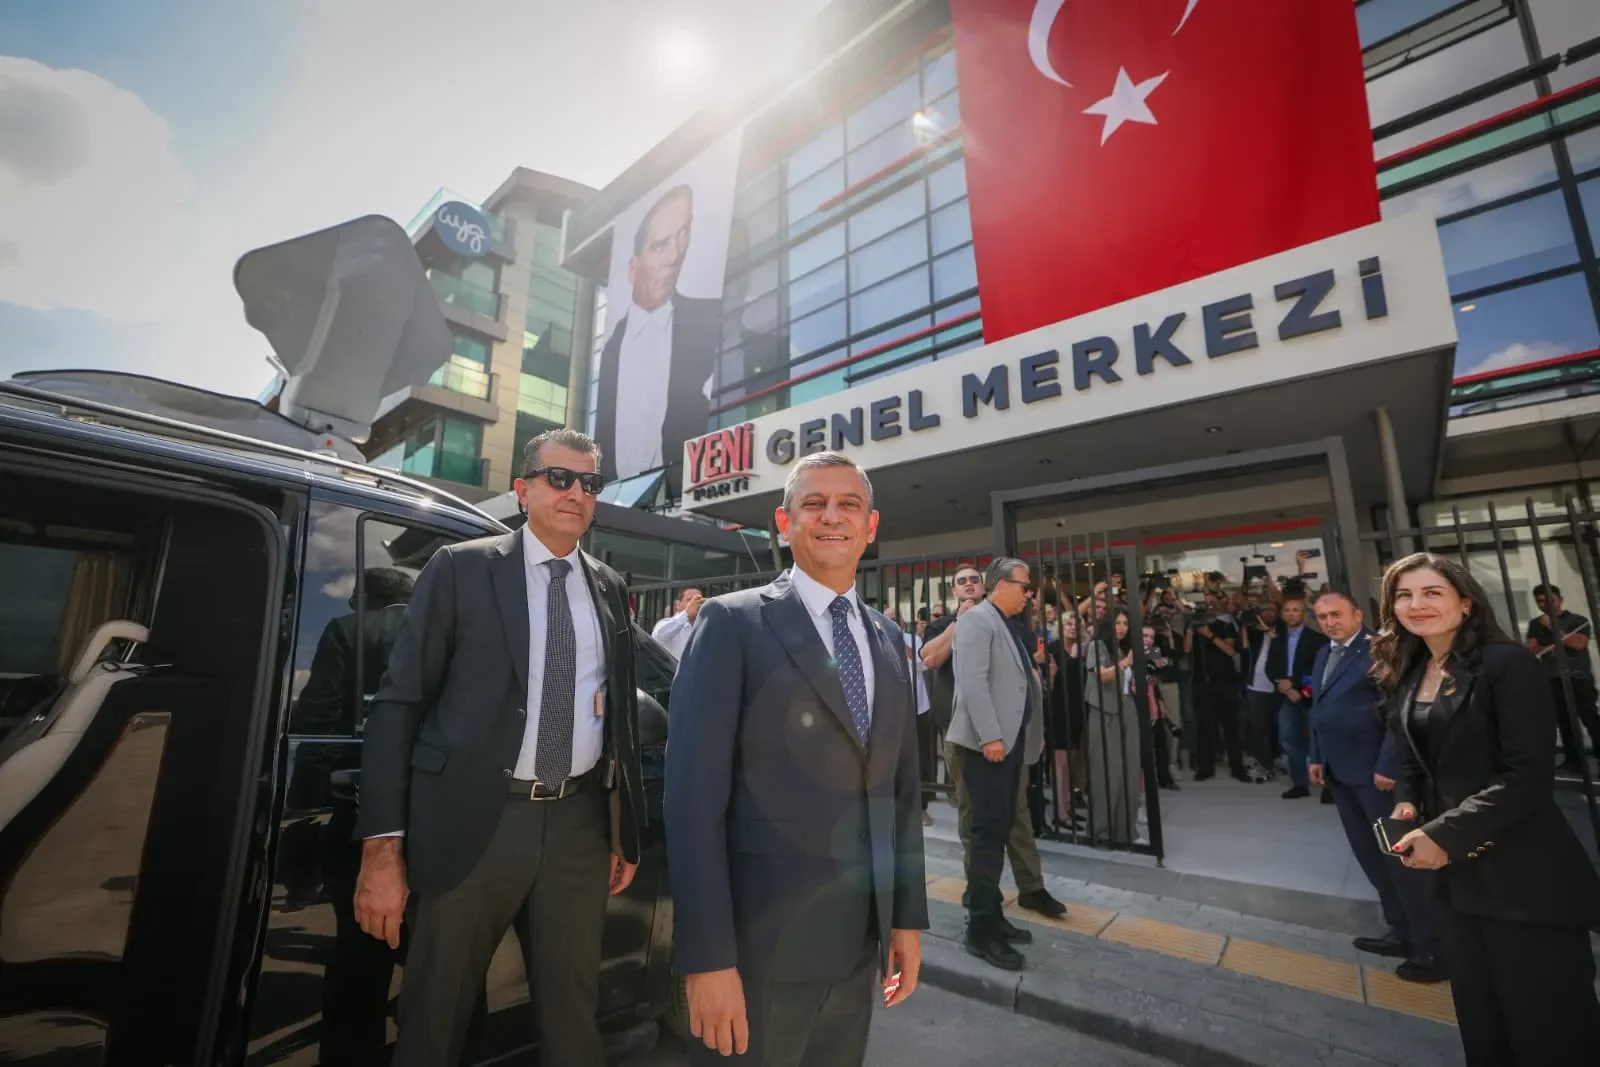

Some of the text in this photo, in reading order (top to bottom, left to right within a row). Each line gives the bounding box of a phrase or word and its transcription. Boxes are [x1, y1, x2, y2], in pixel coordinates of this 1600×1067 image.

[766, 255, 1389, 465] GENEL MERKEZİ
[687, 423, 754, 483] YENİ
